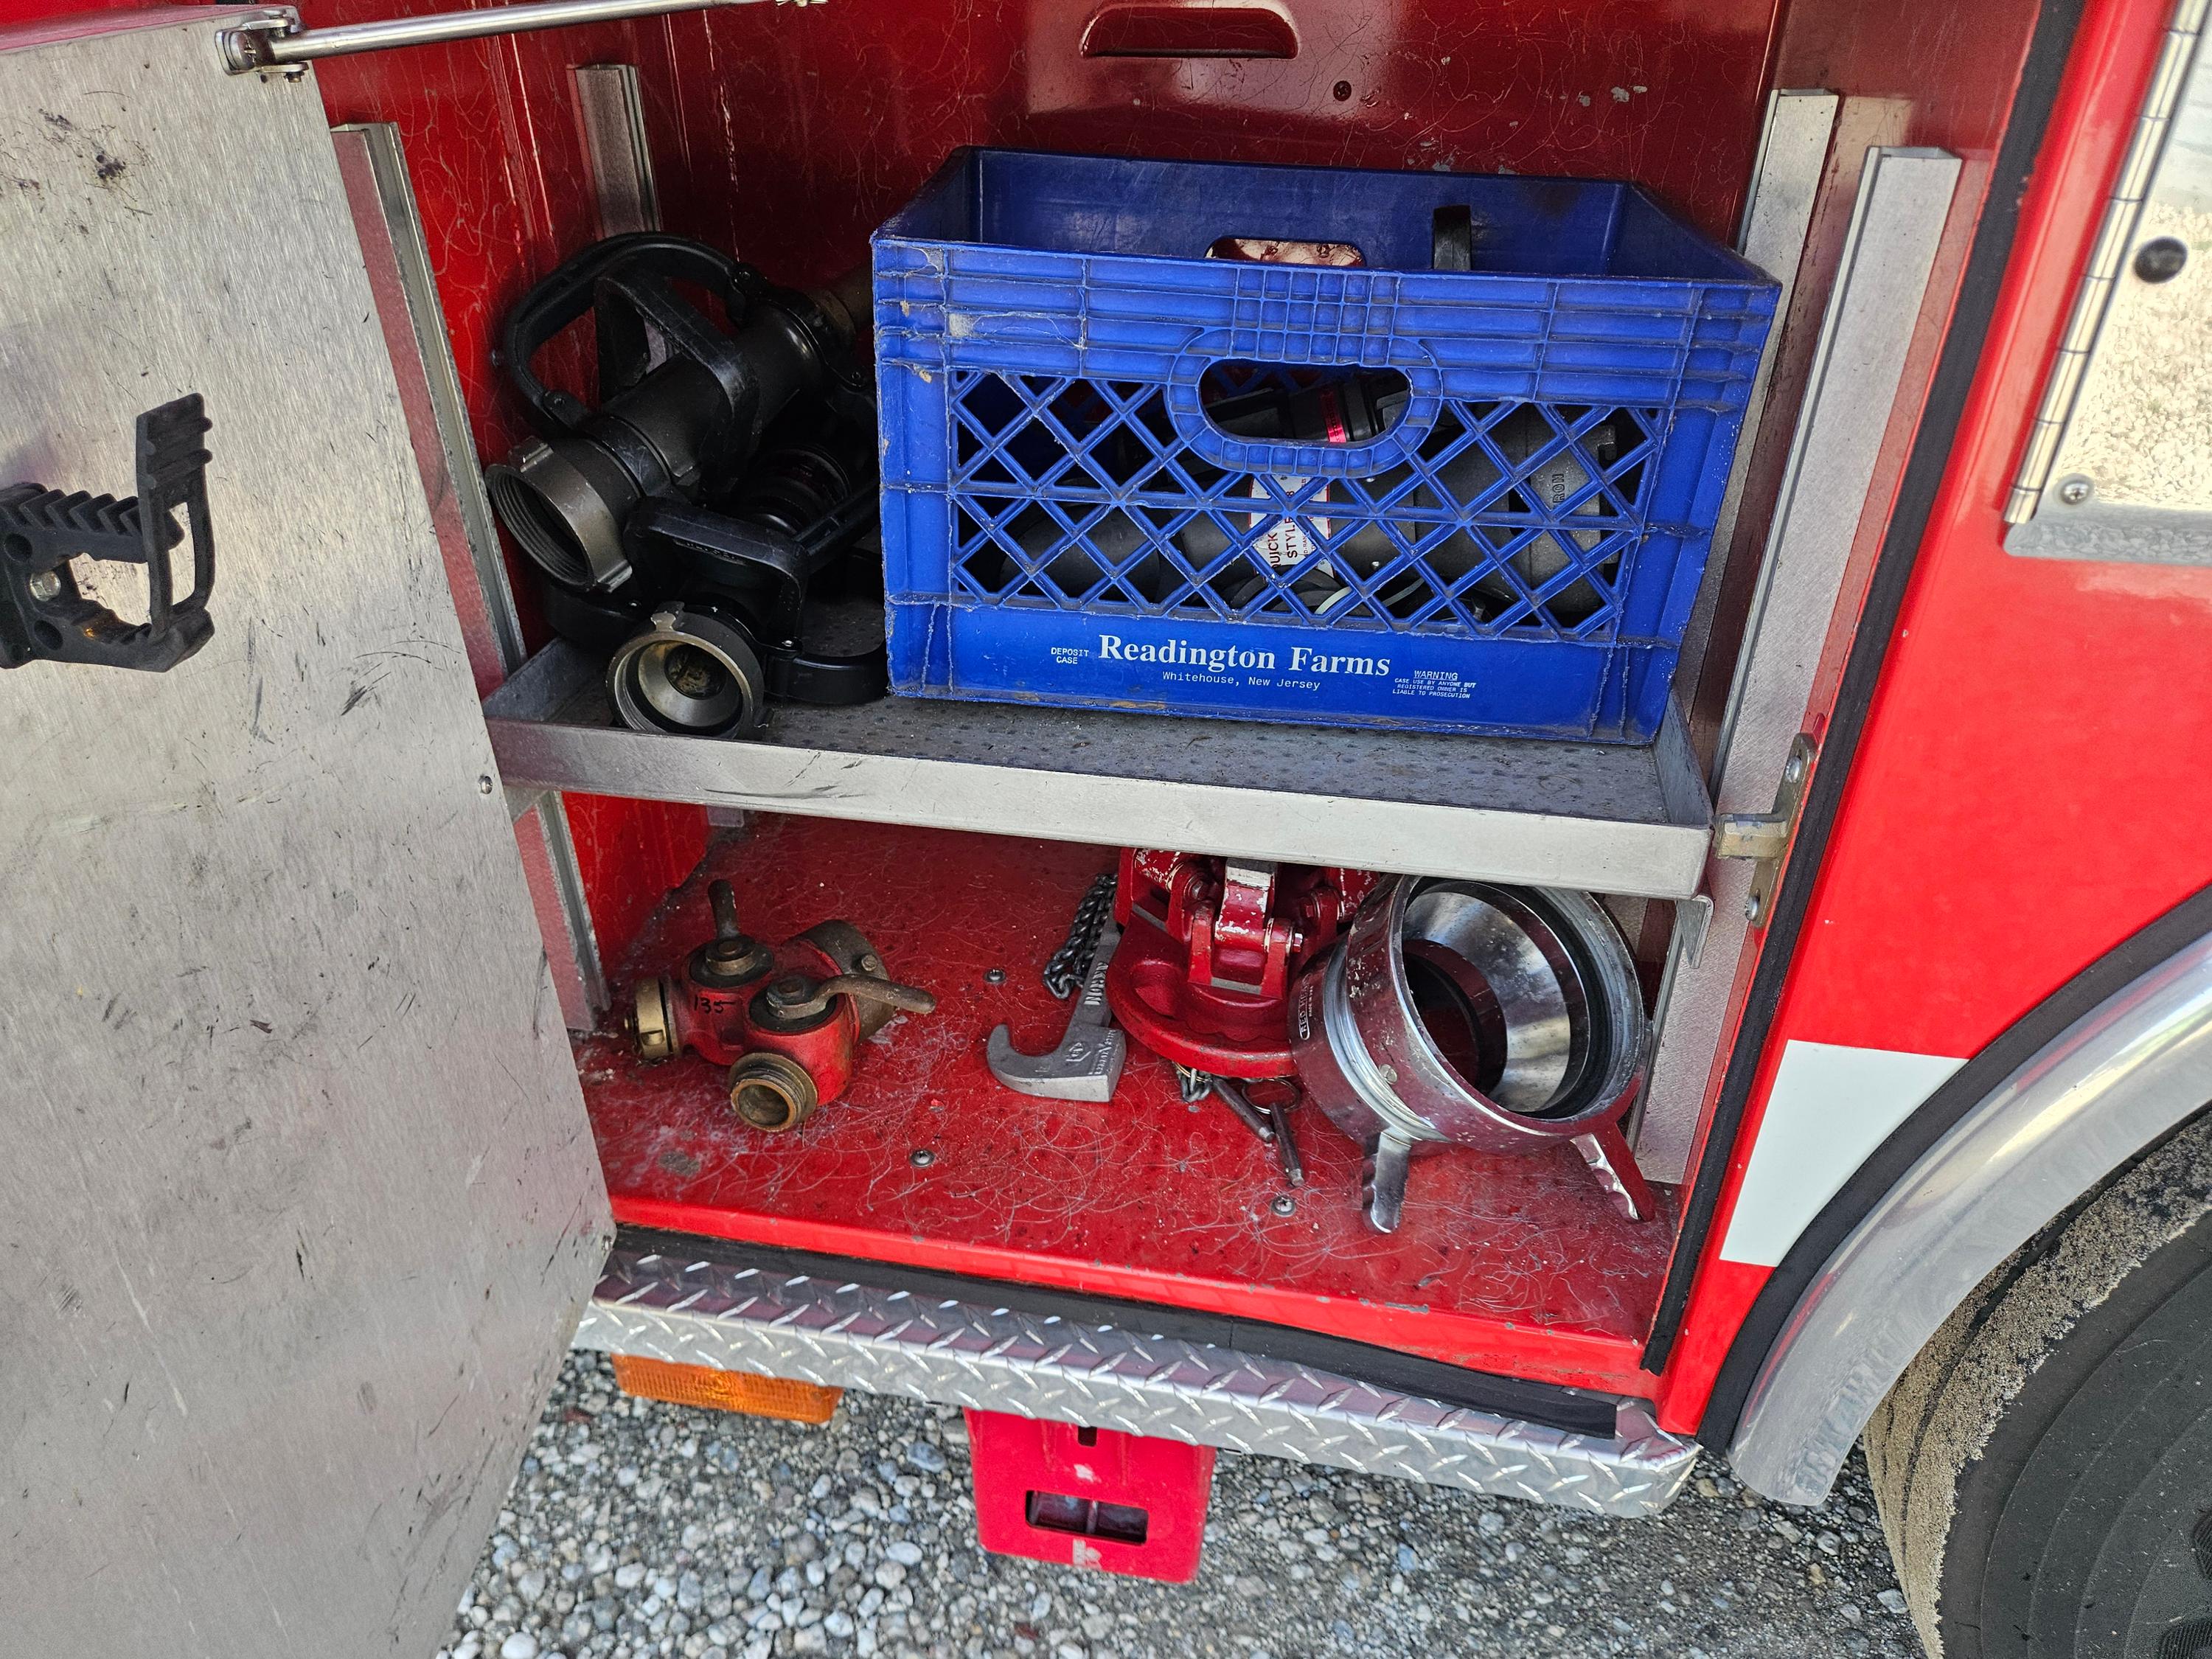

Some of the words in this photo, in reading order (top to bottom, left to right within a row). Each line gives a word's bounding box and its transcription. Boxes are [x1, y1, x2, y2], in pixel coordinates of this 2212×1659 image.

[1552, 473, 1565, 504] RON
[1051, 647, 1090, 657] DEPOSIT
[1056, 655, 1078, 664] CASE
[1098, 634, 1276, 672] Readington
[1288, 646, 1391, 676] Farms
[1162, 671, 1240, 686] Whitehouse,
[1248, 676, 1270, 686] New
[1277, 678, 1321, 691] Jersey
[1414, 670, 1458, 681] WARNING
[694, 994, 737, 1015] 135
[1299, 1010, 1307, 1033] RED
